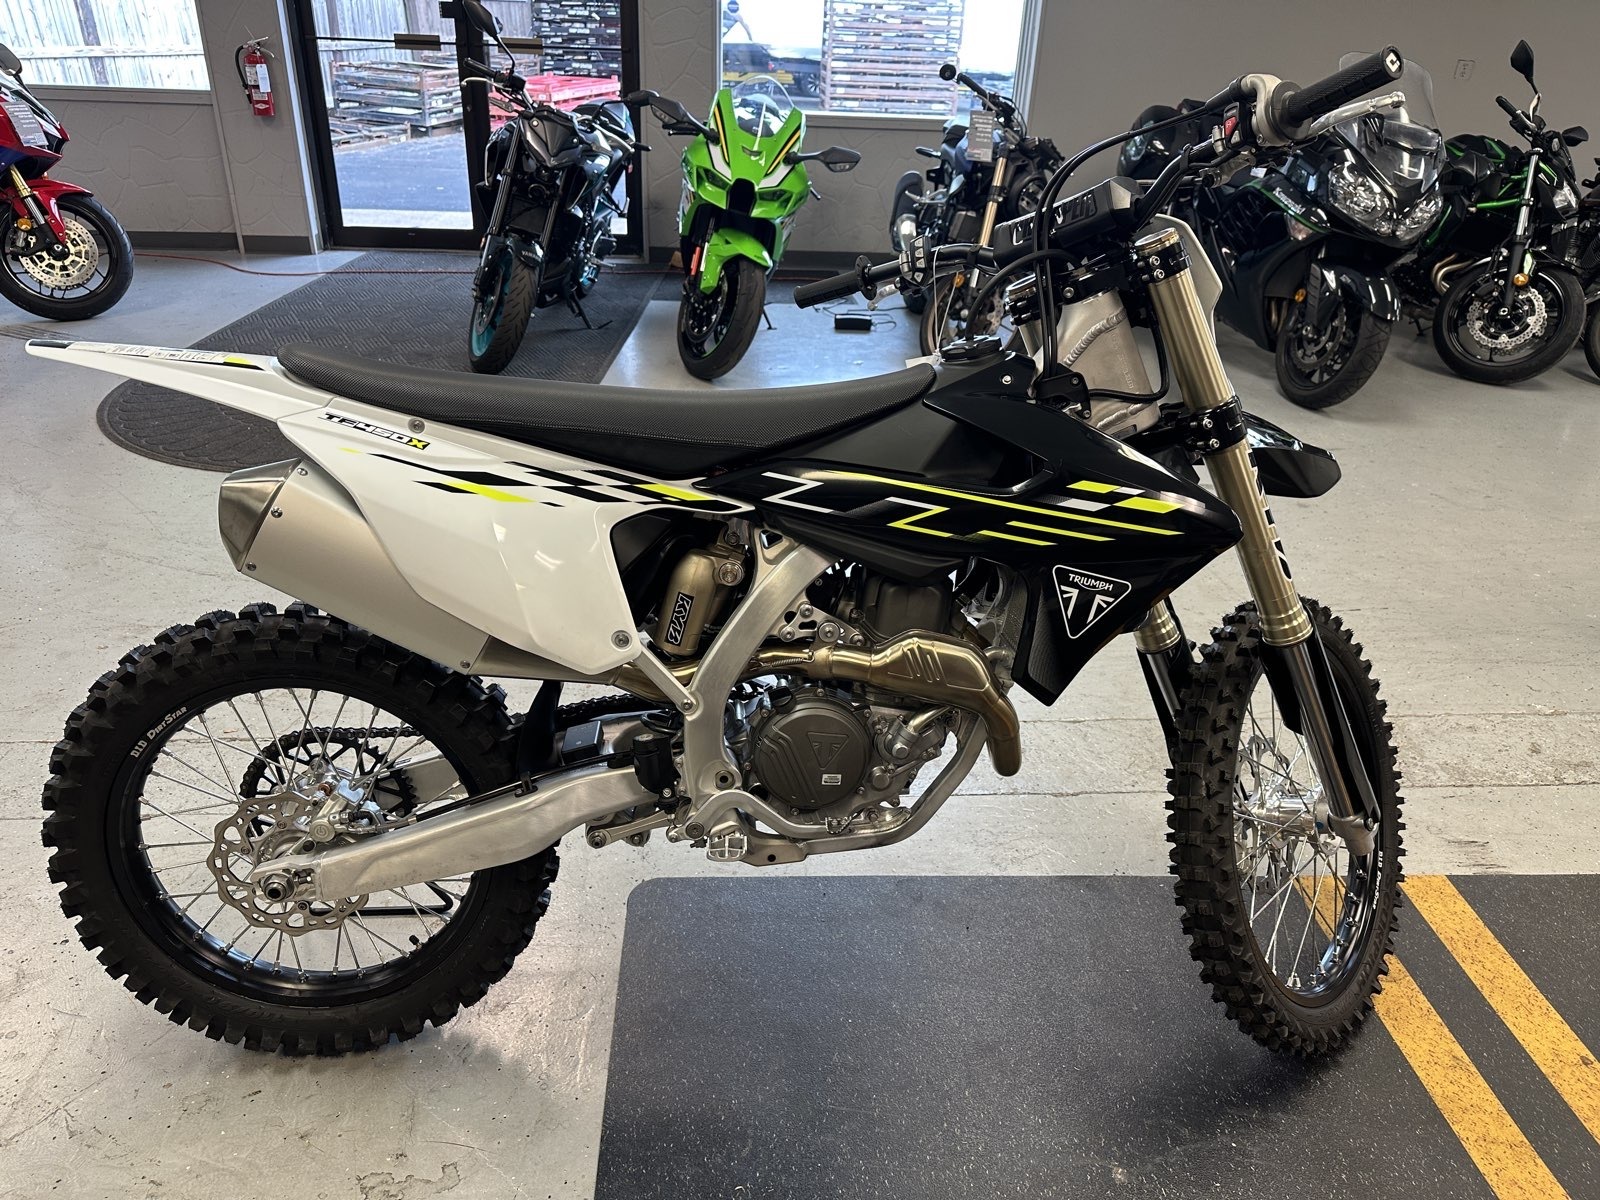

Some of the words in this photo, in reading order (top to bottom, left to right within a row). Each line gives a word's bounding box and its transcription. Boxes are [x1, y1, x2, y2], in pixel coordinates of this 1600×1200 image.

[318, 412, 430, 450] TF450X
[1068, 573, 1114, 592] TRIUMPH
[667, 593, 692, 645] KYB
